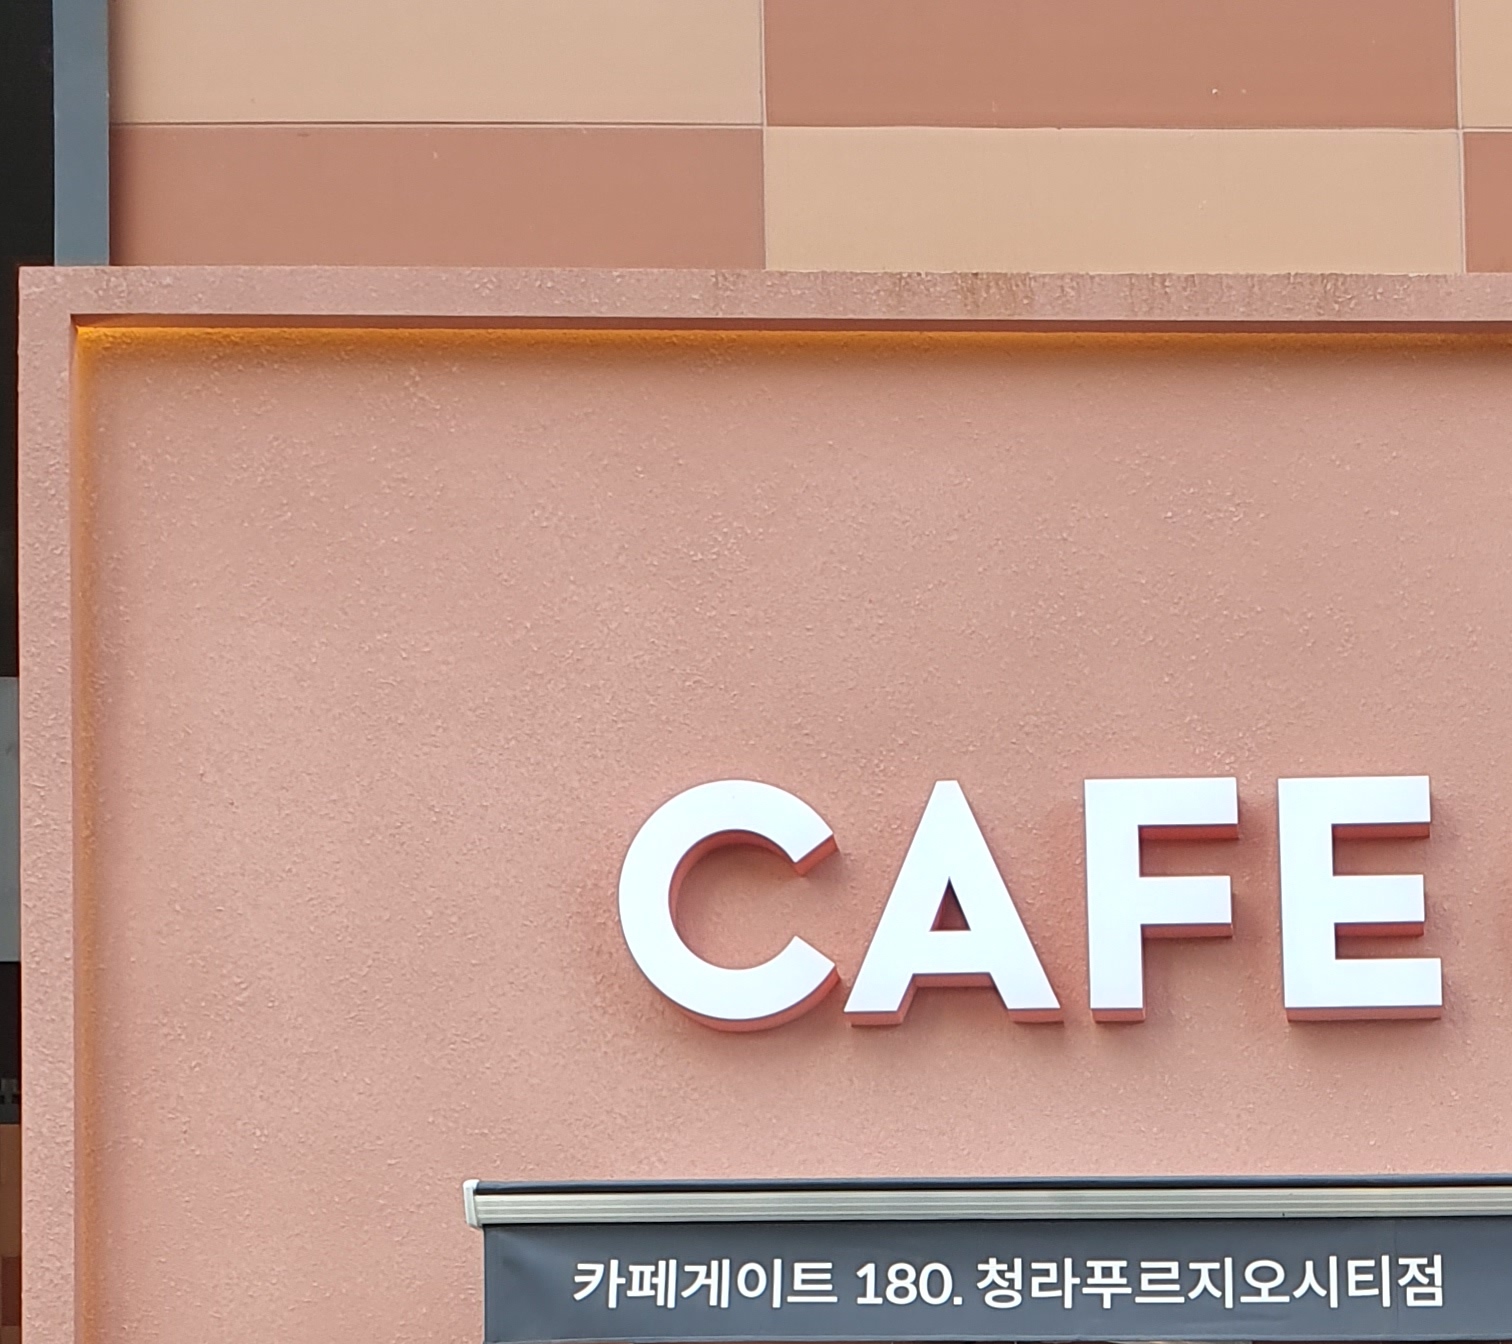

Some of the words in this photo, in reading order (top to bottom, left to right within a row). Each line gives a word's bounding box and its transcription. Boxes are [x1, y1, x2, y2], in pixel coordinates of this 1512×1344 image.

[619, 773, 1443, 1026] CAFE
[572, 1257, 840, 1310] 카페게이트
[855, 1260, 965, 1306] 180.
[975, 1254, 1445, 1310] 청라푸르지오시티점
